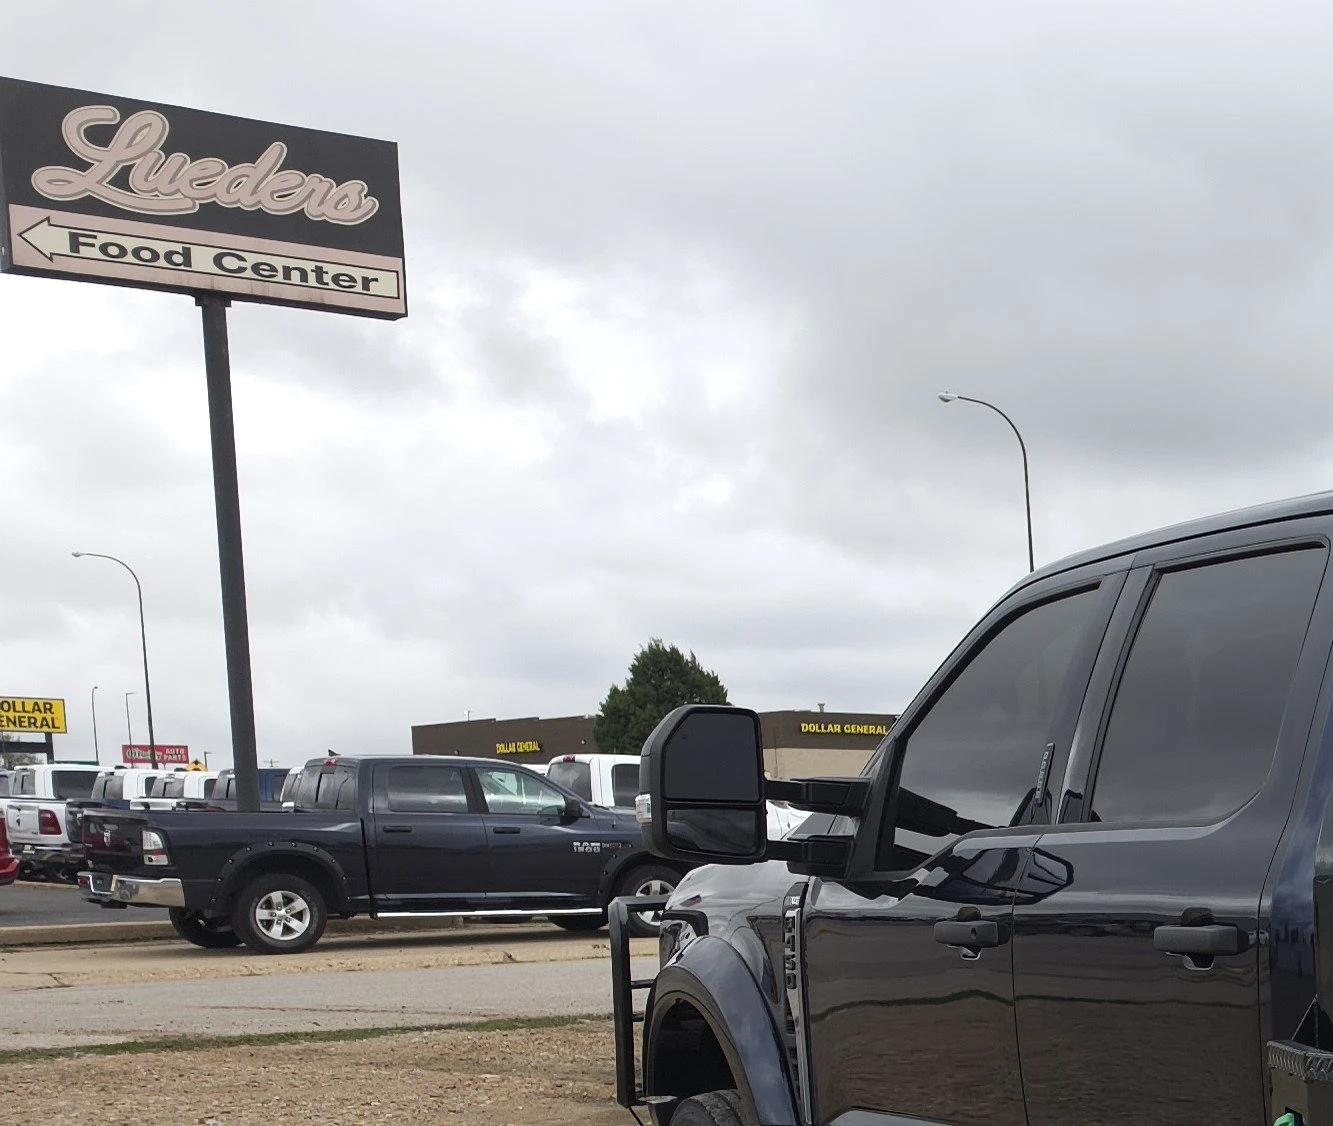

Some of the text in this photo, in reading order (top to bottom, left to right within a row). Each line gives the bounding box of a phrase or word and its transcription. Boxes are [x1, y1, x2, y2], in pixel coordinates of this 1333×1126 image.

[31, 105, 379, 225] Lueders
[68, 231, 378, 292] Food Center
[496, 740, 540, 754] DOLLAR GENERAL
[801, 723, 887, 735] DOLLAR GENERAL
